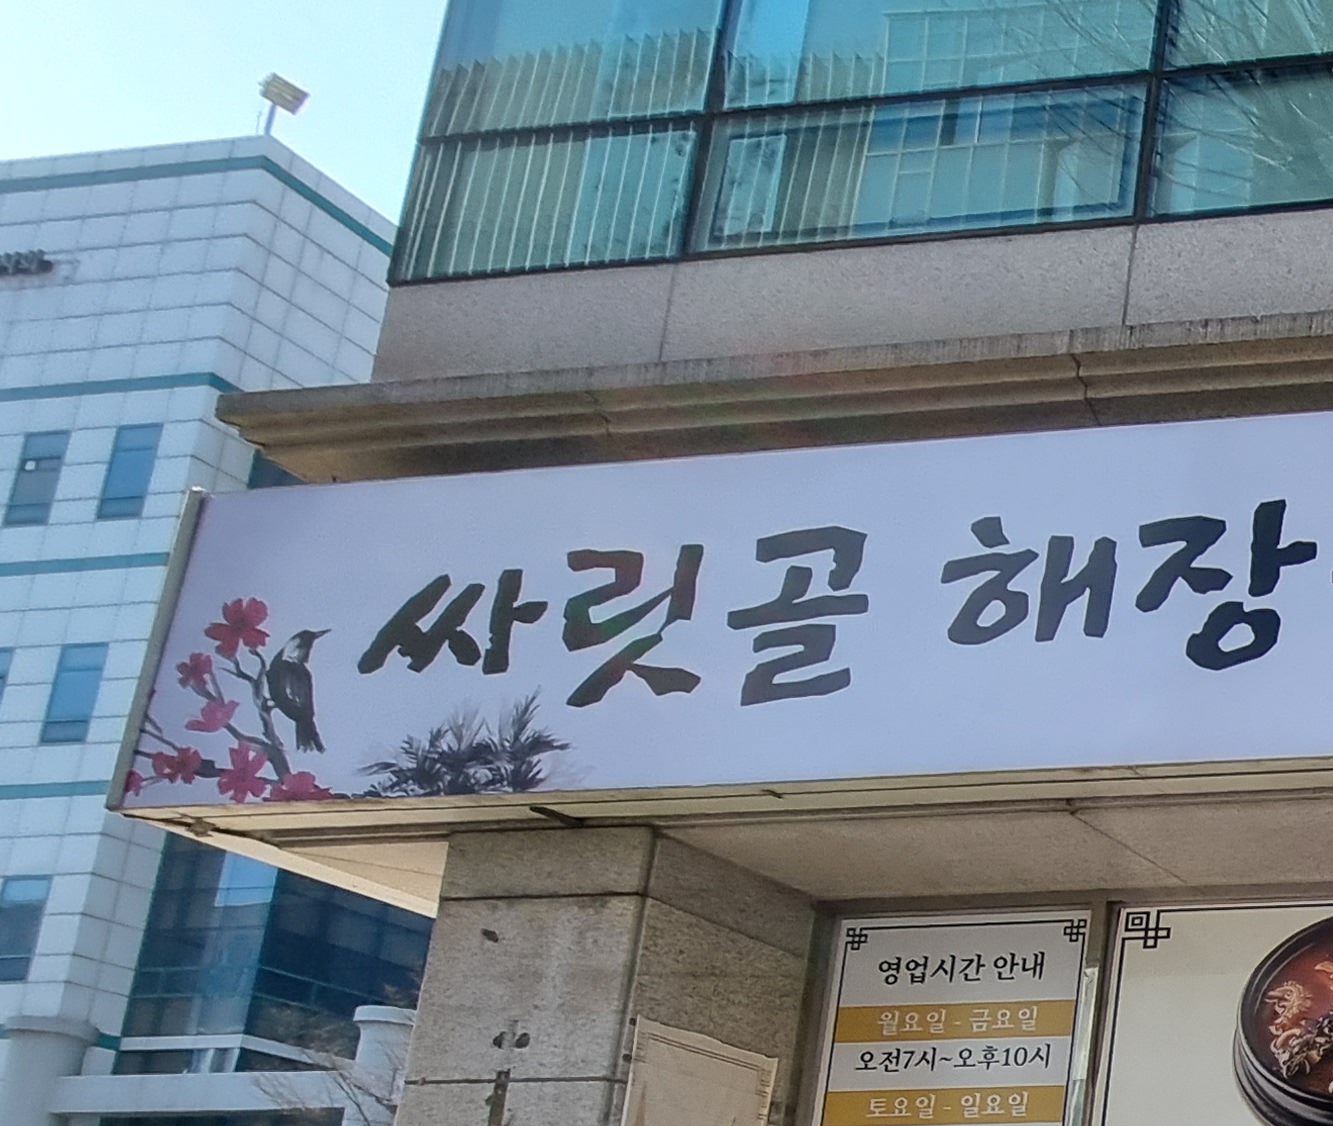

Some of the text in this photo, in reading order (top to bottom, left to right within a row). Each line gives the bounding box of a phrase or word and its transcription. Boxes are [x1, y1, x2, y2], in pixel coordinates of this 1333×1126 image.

[357, 526, 869, 708] 싸릿골
[879, 952, 1045, 985] 영업시간 안내
[877, 1008, 948, 1037] 월요일
[968, 1004, 1039, 1034] 금요일
[865, 1093, 937, 1119] 토요일
[959, 1090, 1029, 1118] 일요일
